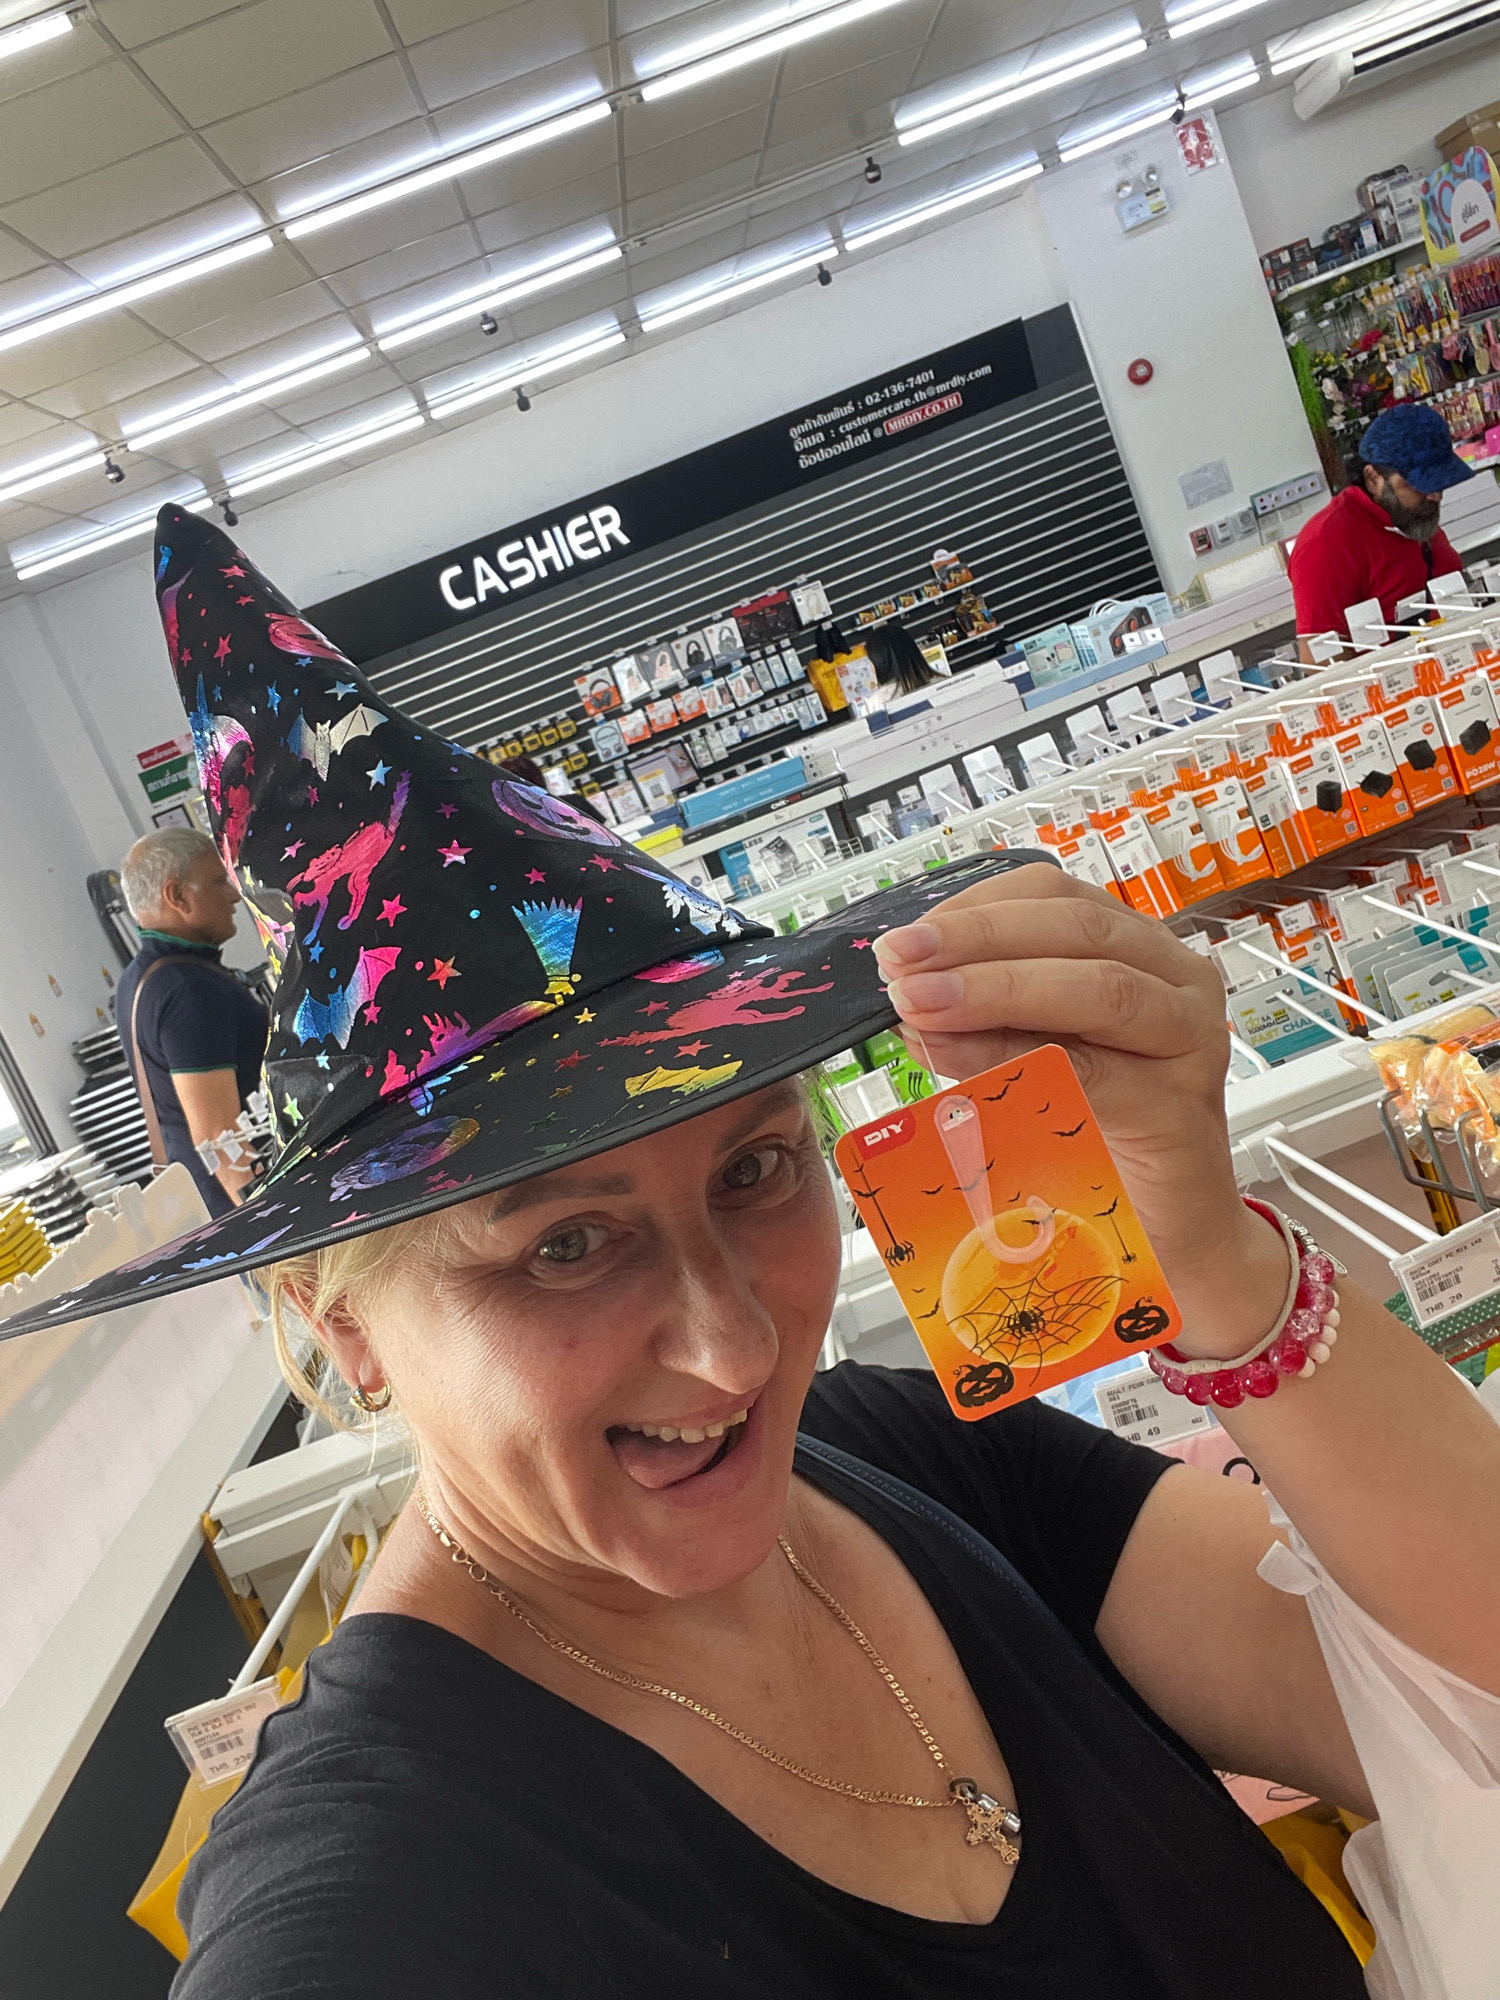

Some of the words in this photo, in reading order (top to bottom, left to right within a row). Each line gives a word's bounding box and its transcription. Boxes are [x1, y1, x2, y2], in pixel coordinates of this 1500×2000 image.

[864, 369, 936, 407] 02-136-7401
[886, 395, 960, 434] MRDIY.CO.TH
[793, 432, 826, 453] อีเมล
[439, 504, 631, 610] CASHIER
[1249, 1027, 1280, 1046] FAST
[863, 1119, 905, 1147] DIY
[1425, 1301, 1445, 1316] THB
[1448, 1292, 1463, 1305] 20
[1147, 1426, 1161, 1437] 49
